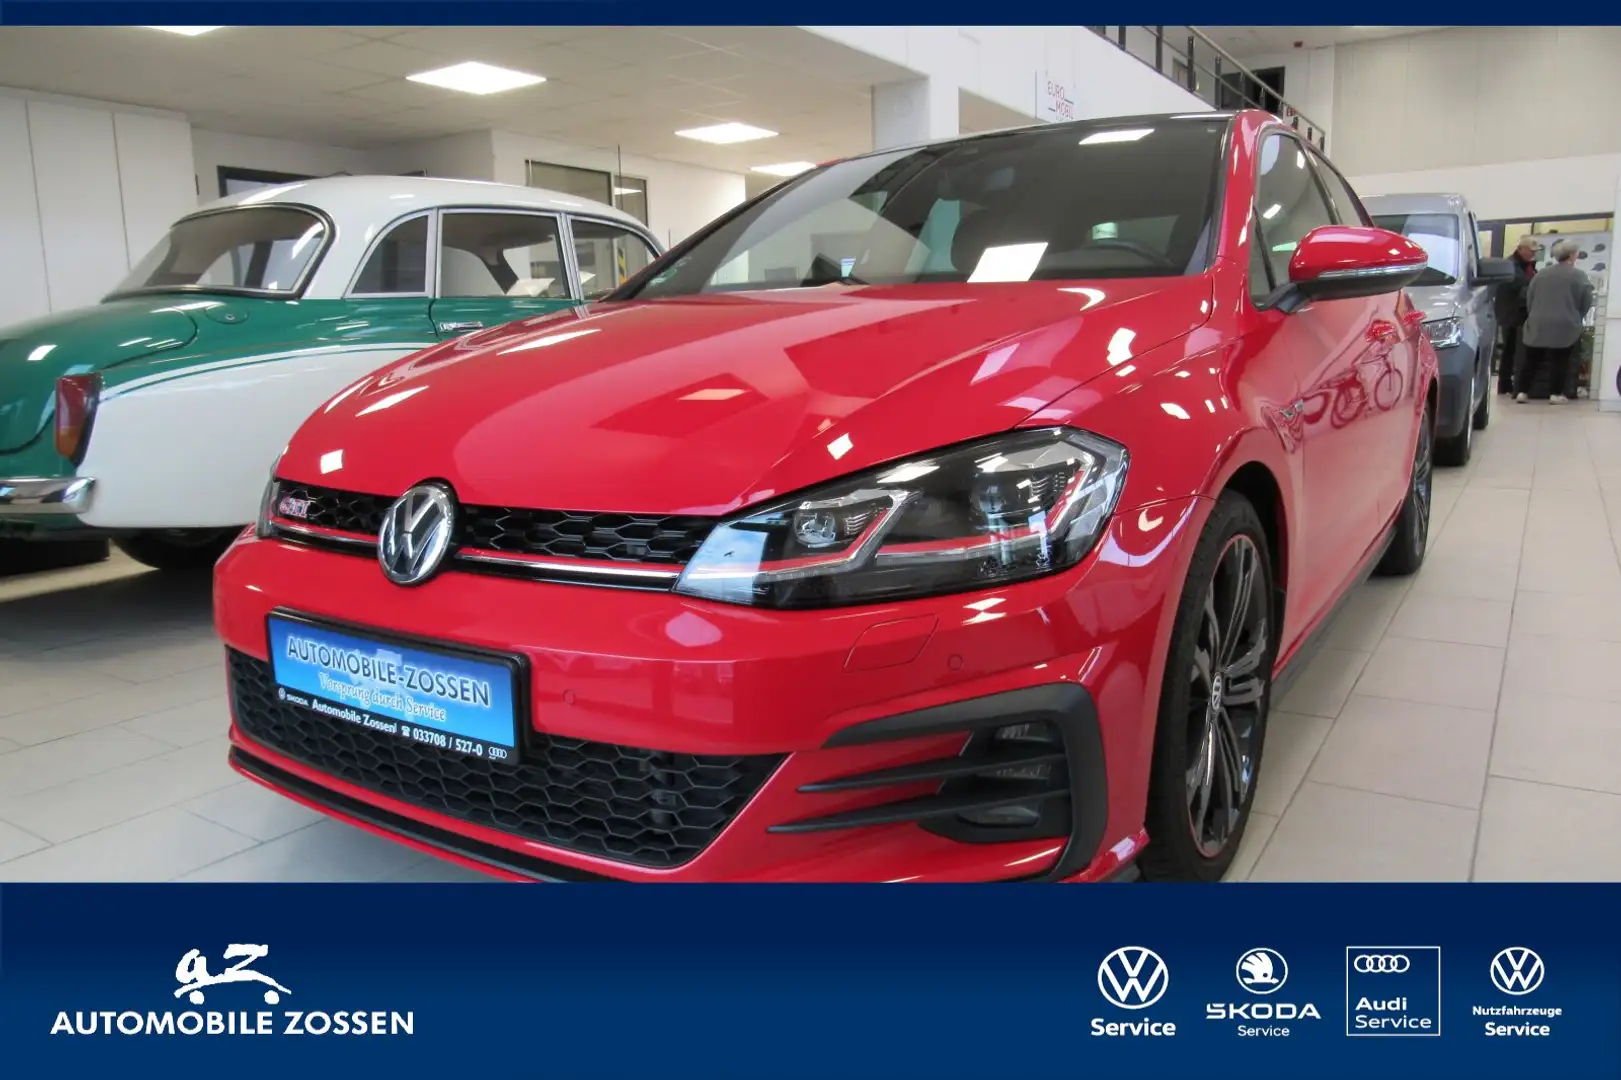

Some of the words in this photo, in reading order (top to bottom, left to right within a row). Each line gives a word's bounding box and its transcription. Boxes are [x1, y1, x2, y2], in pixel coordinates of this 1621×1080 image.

[288, 637, 491, 707] AUTOMOBILE-ZOSSEN
[319, 672, 372, 708] Vorsprung
[372, 686, 404, 711] durch
[405, 696, 447, 721] Service
[312, 699, 362, 723] Automobile
[413, 727, 447, 747] 033708
[455, 738, 483, 756] 527-0
